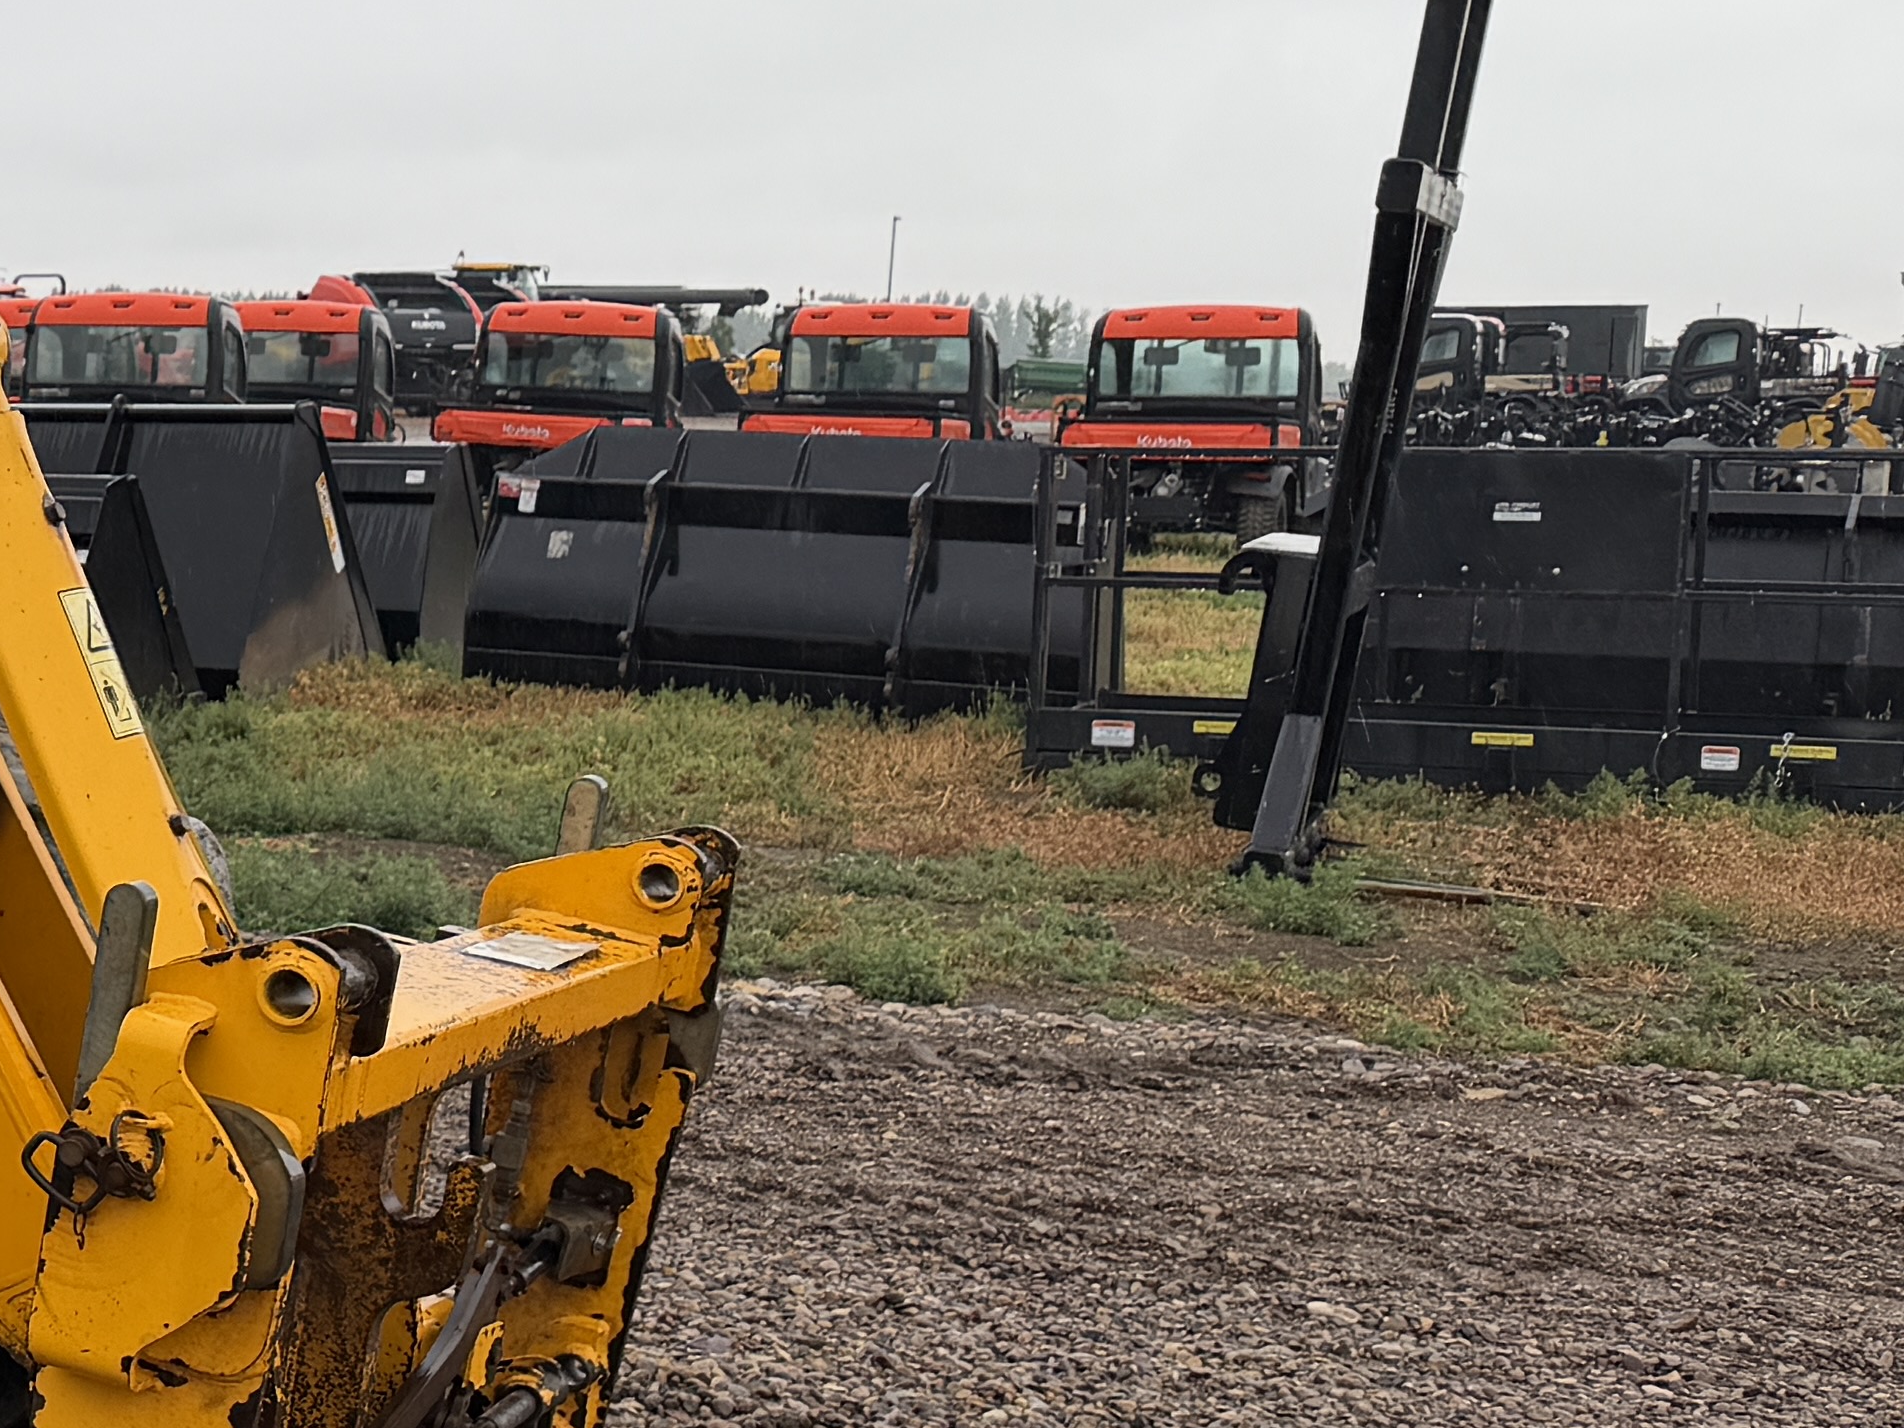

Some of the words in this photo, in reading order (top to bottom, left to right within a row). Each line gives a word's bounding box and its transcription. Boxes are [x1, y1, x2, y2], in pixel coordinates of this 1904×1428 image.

[411, 319, 446, 331] KUBOTA
[502, 423, 550, 439] Kubota
[1137, 434, 1192, 449] Kubota
